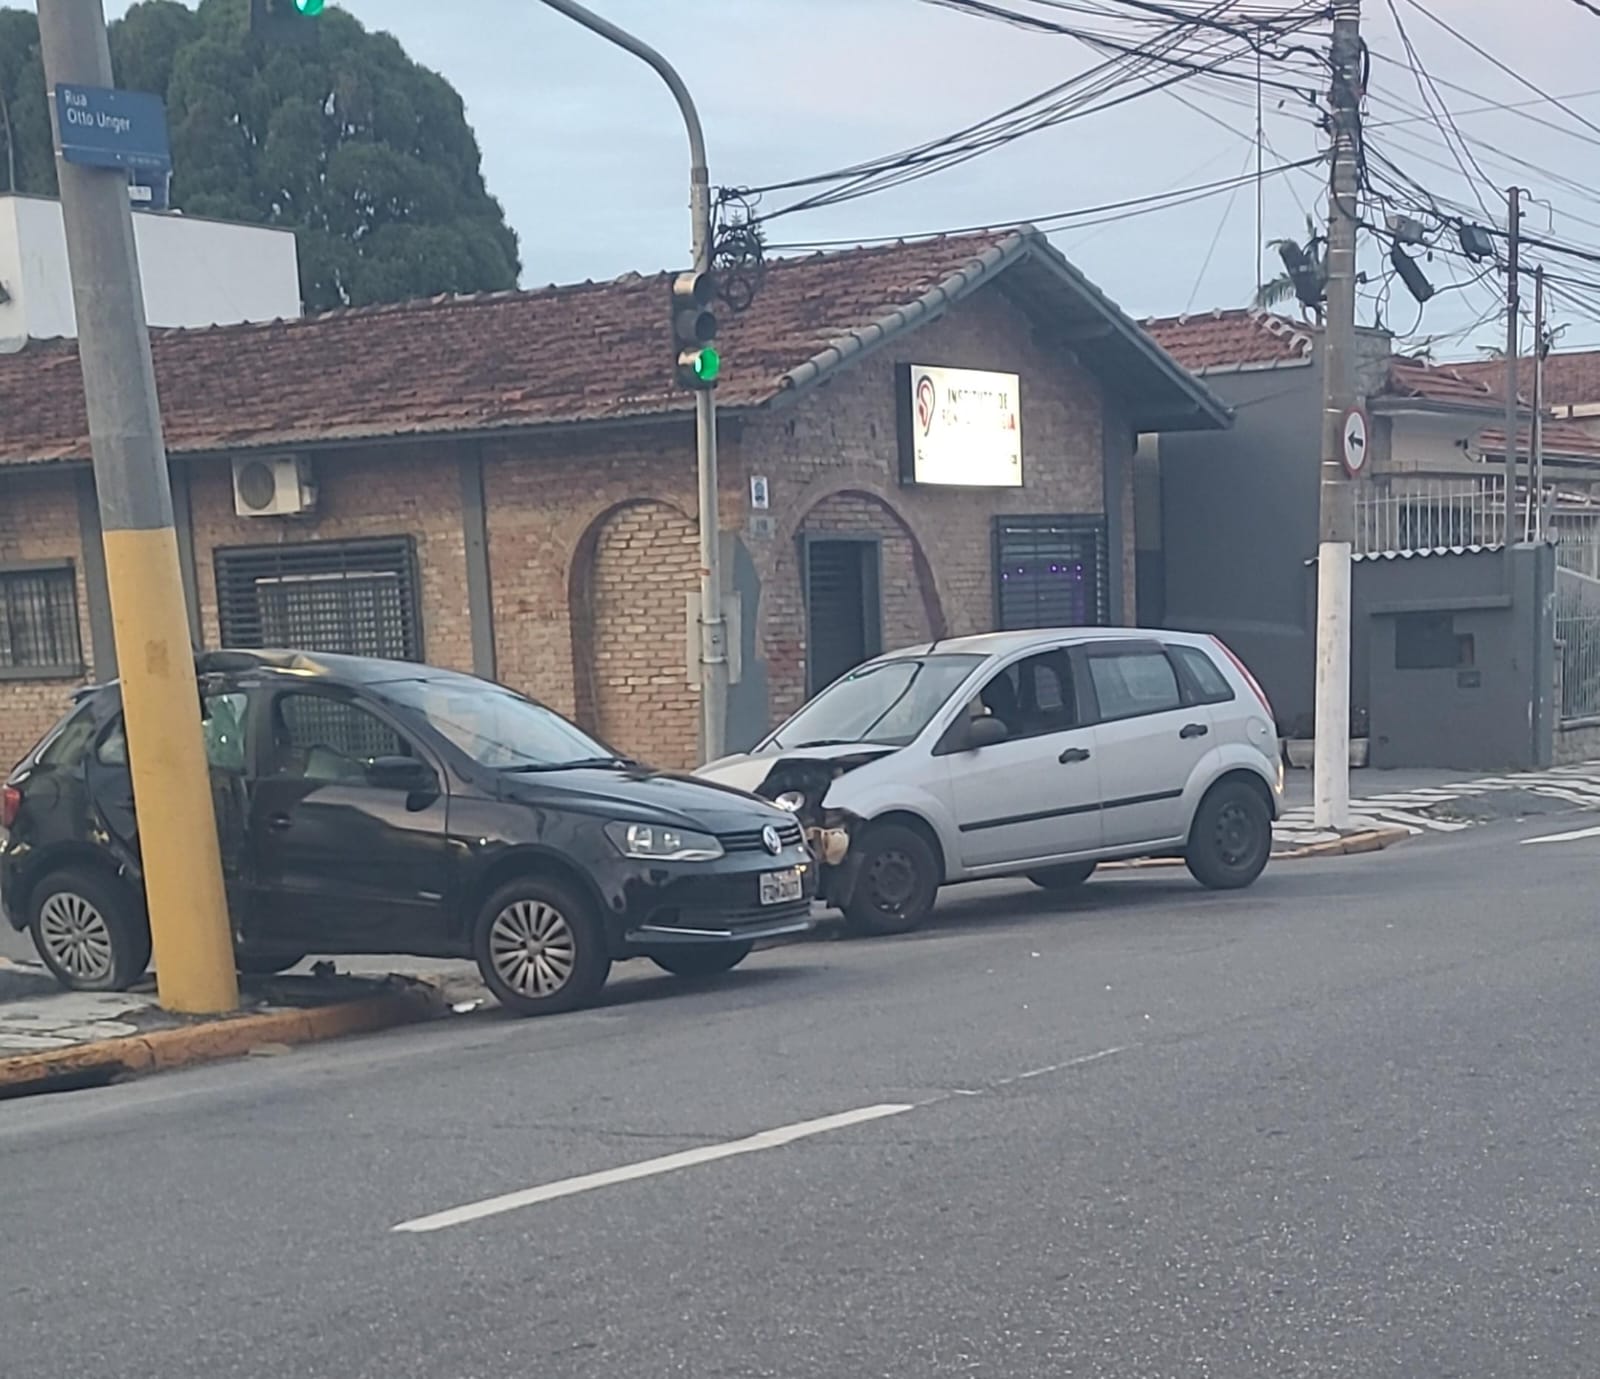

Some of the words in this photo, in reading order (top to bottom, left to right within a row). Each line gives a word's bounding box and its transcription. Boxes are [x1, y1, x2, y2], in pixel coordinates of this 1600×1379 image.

[64, 89, 87, 106] Rua
[66, 107, 94, 127] Otto
[97, 111, 130, 134] Unger
